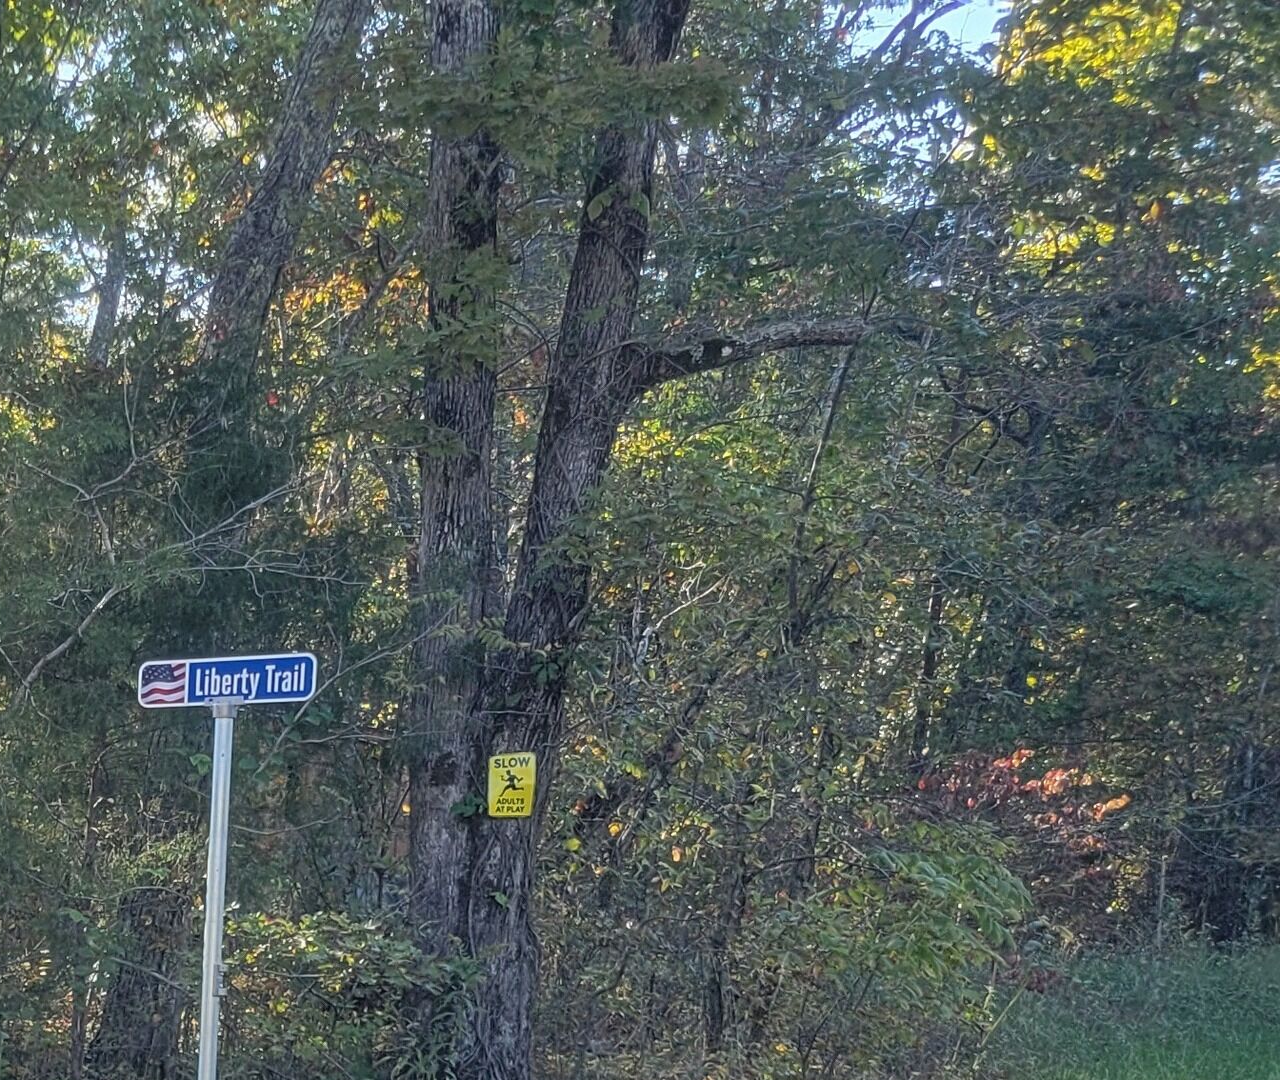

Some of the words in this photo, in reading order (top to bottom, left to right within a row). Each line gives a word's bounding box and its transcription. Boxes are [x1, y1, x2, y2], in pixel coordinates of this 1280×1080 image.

[195, 667, 260, 699] Liberty
[265, 662, 306, 693] Trail
[494, 757, 531, 769] SLOW
